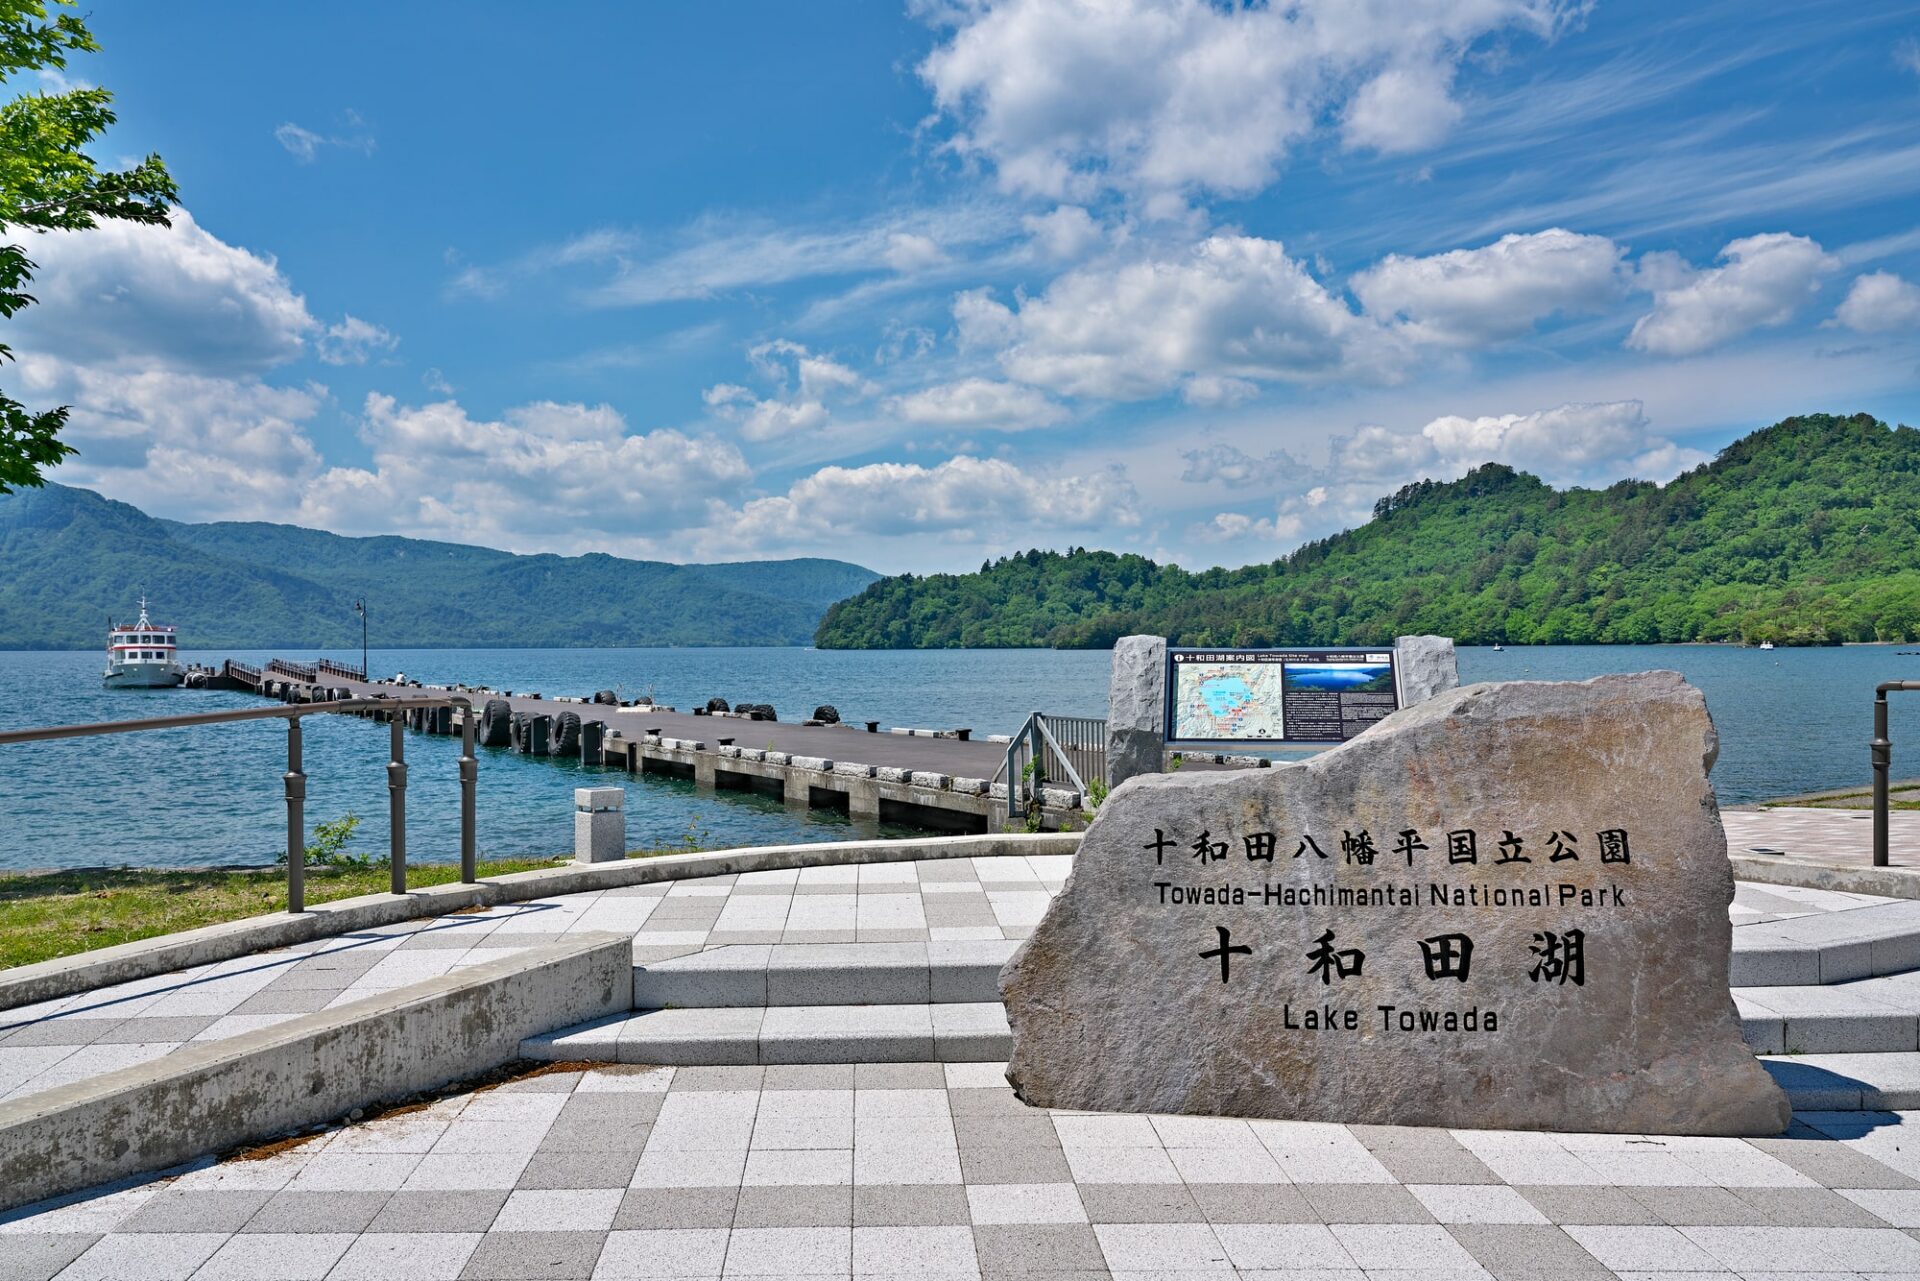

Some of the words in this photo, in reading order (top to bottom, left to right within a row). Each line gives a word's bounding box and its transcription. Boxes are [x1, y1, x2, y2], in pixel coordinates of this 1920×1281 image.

[1185, 654, 1256, 662] 十和田湖案内図
[1142, 828, 1631, 867] 十和田八幡平国立公園
[1153, 881, 1419, 908] Towada-Hachimantai
[1430, 882, 1550, 908] National
[1558, 883, 1626, 908] Park
[1198, 925, 1586, 987] 十和田湖
[1283, 1003, 1358, 1032] Lake
[1377, 1005, 1499, 1032] Towada
